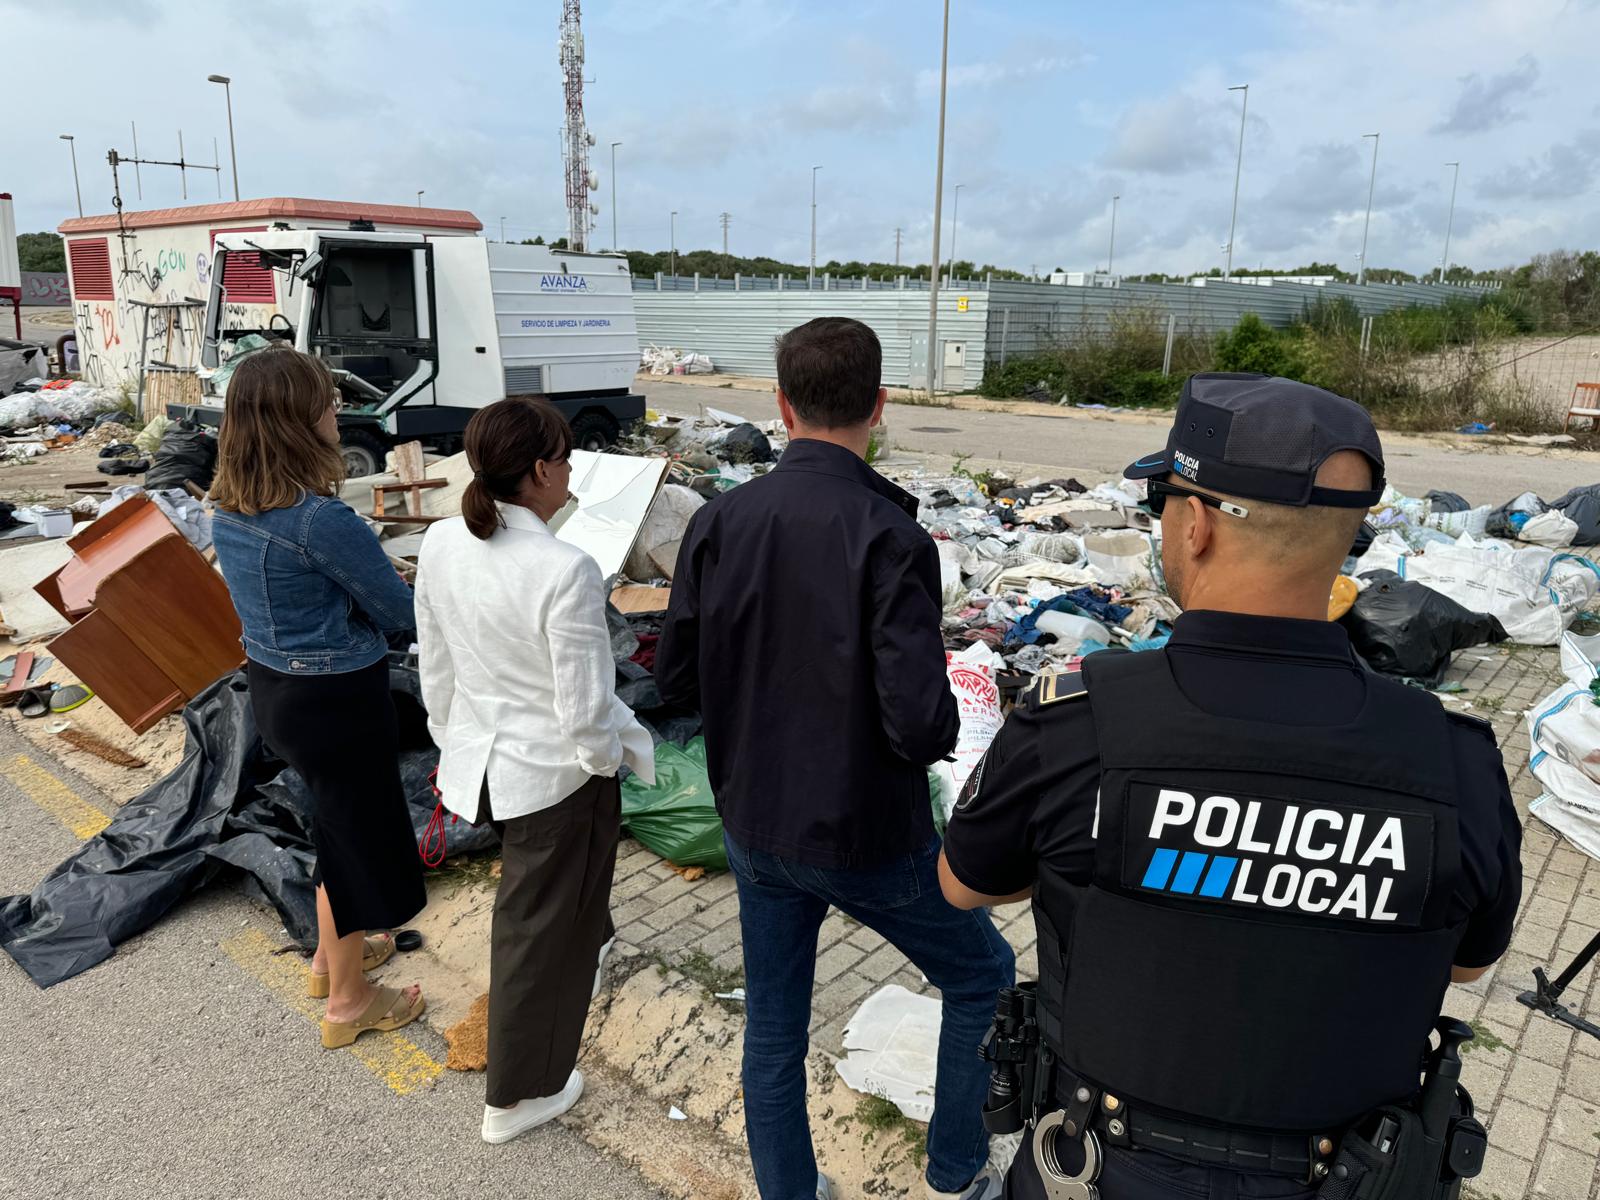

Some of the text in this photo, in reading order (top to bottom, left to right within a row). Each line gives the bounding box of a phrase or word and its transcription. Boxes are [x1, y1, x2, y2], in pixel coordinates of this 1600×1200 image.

[540, 274, 587, 288] AVANZA
[521, 320, 546, 328] SERVICIO
[547, 320, 554, 328] DE
[555, 320, 577, 328] LIMPIEZA
[583, 319, 611, 327] JARDINERIA
[1174, 450, 1200, 470] POLICIA
[1181, 465, 1197, 481] LOCAL
[1148, 789, 1406, 871] POLICIA
[1231, 859, 1398, 921] LOCAL
